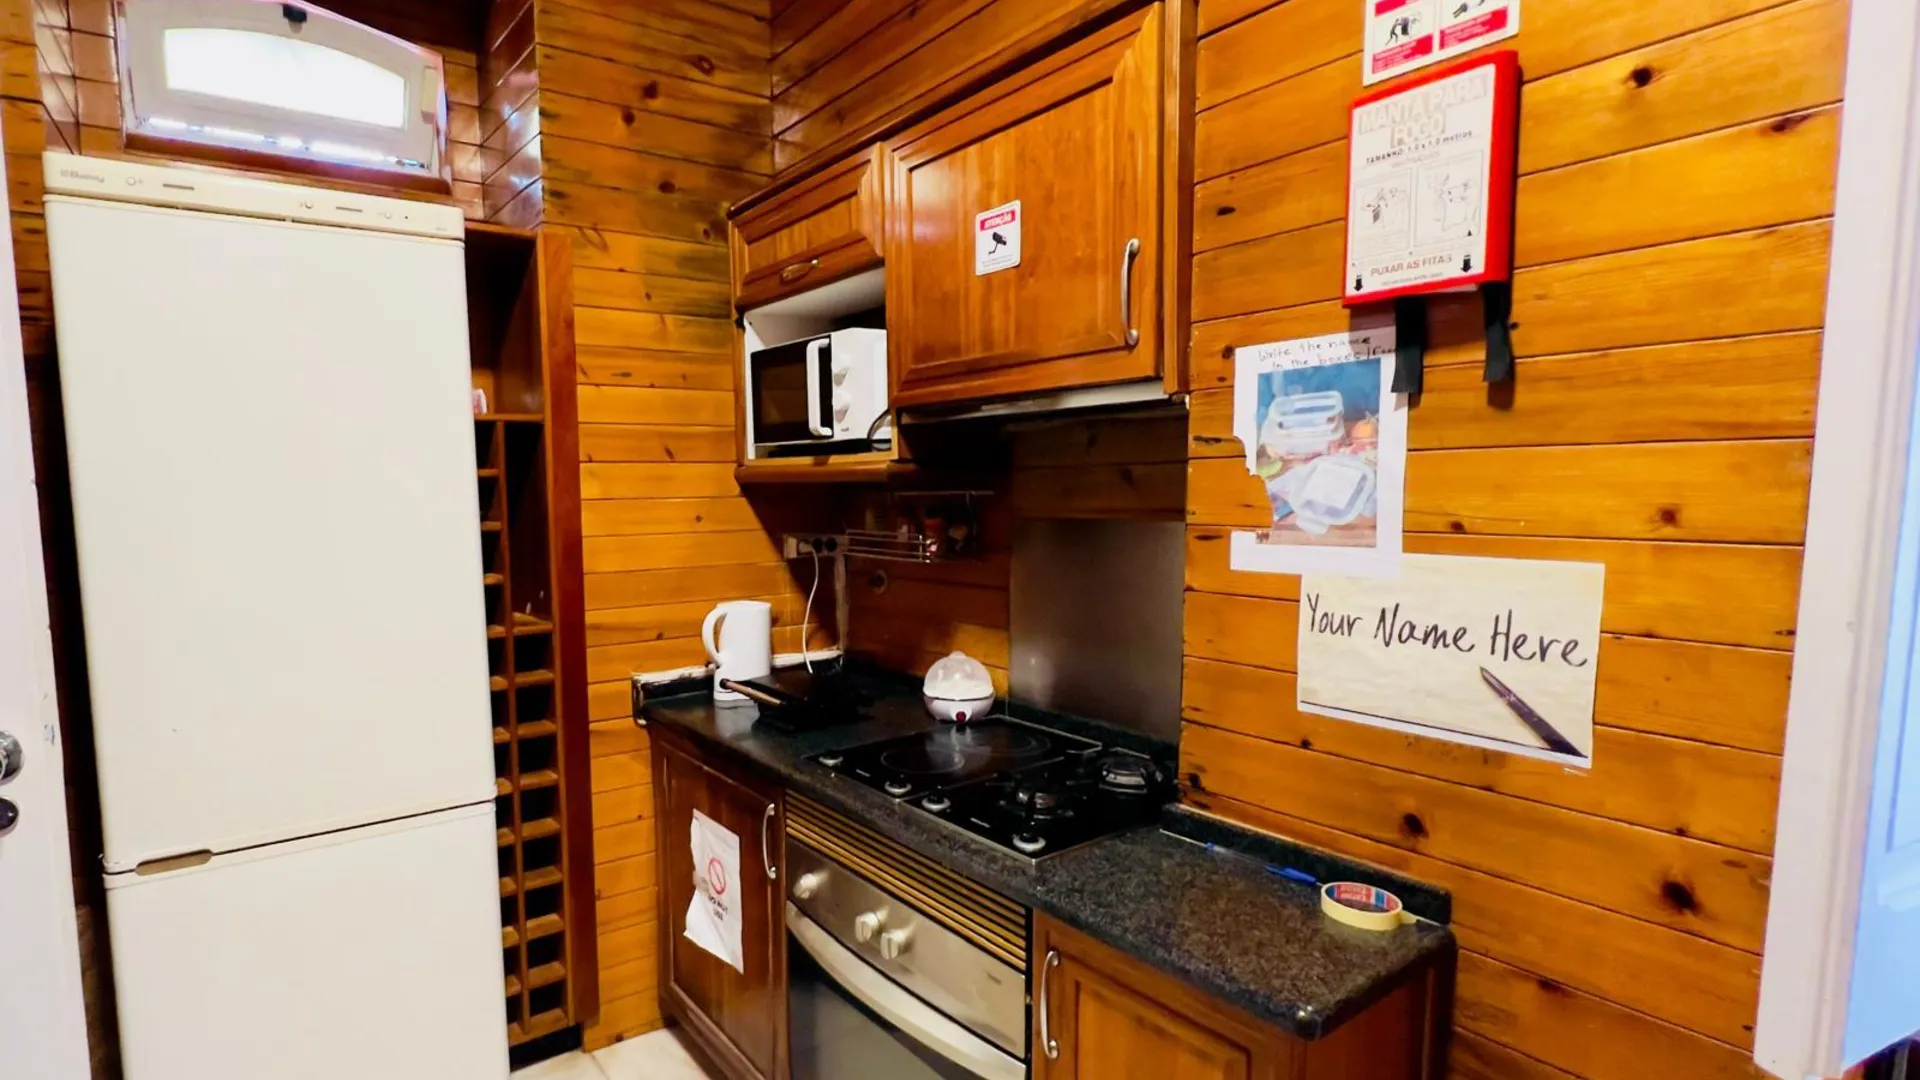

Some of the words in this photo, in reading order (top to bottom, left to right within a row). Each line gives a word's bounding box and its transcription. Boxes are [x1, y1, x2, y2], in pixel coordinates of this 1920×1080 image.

[1370, 262, 1404, 276] PUXAR
[1406, 259, 1420, 270] AS
[1422, 253, 1453, 267] FITAS
[1257, 348, 1291, 362] Write
[1299, 342, 1321, 354] the
[1328, 336, 1371, 348] name
[1291, 359, 1308, 367] the
[1306, 593, 1363, 637] Your
[1373, 603, 1476, 652] Name
[1490, 609, 1588, 668] Here
